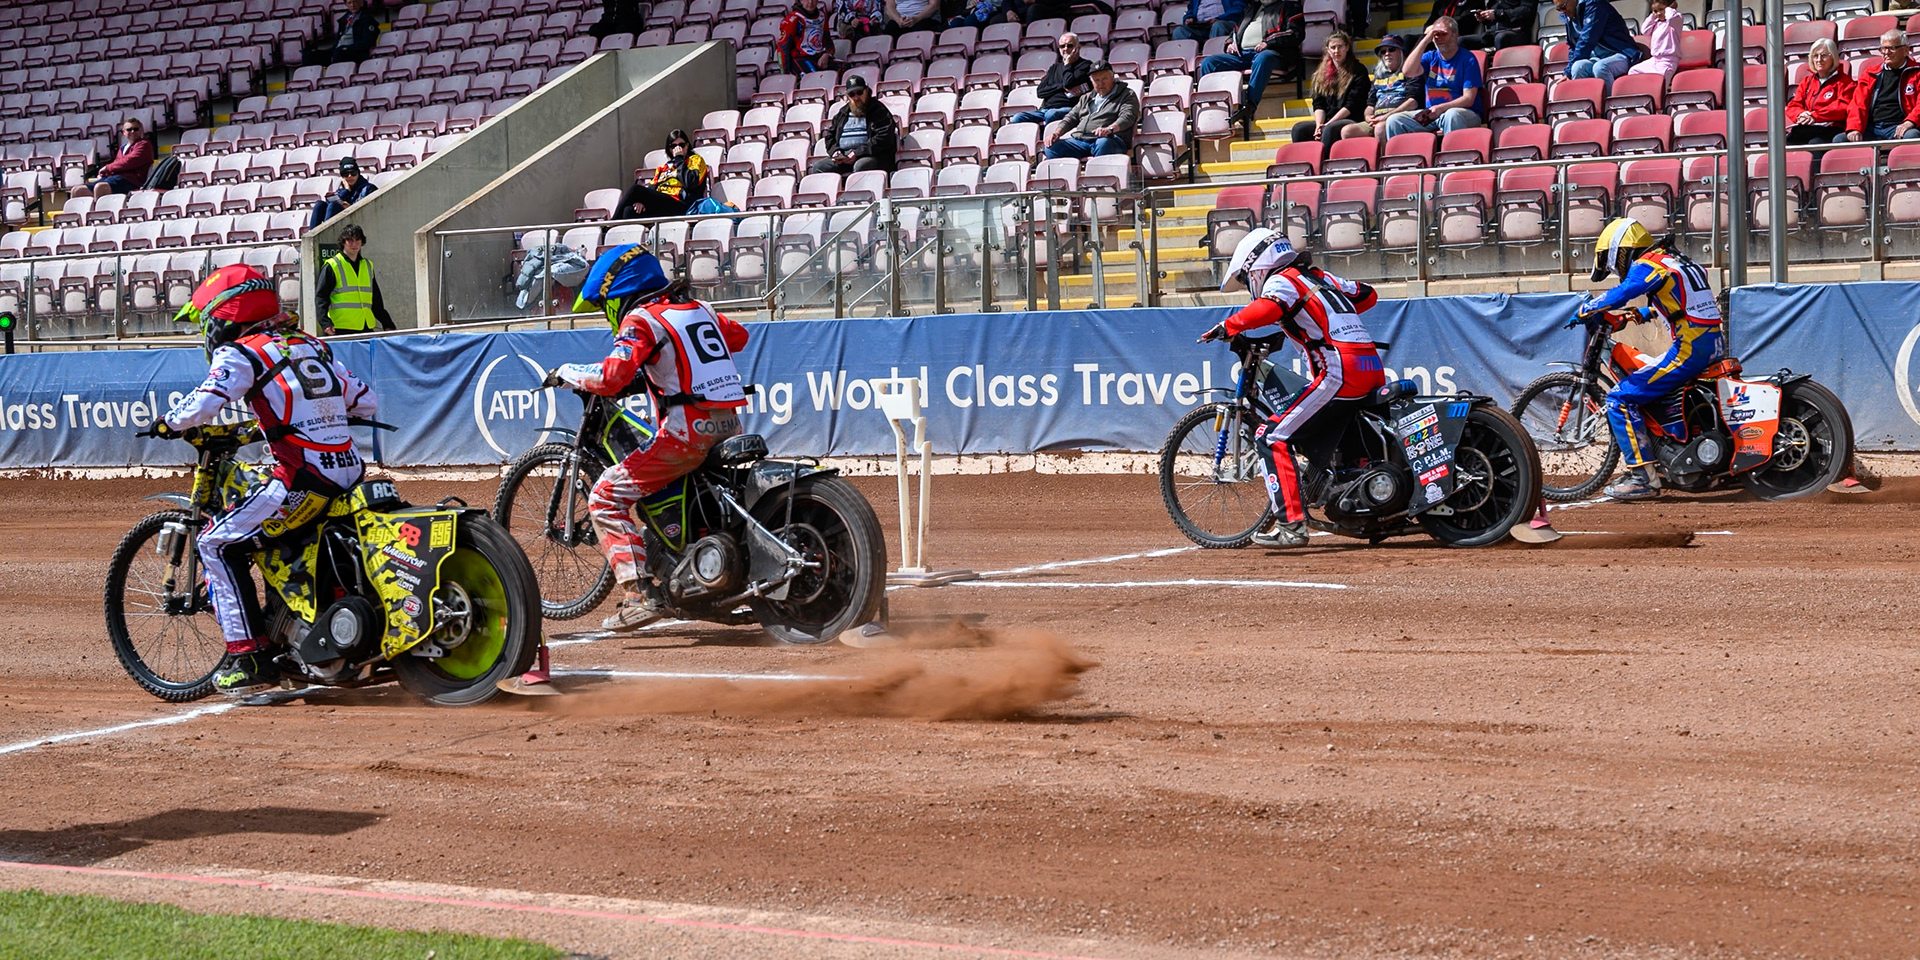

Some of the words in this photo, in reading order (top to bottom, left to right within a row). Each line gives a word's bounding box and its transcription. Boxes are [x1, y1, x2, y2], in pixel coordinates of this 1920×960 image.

[697, 324, 726, 357] 6
[299, 359, 334, 395] 9
[692, 382, 706, 392] THE
[706, 376, 725, 387] SLIDE
[945, 365, 1059, 408] Class
[1073, 360, 1212, 406] Travel
[62, 390, 158, 429] Travel
[488, 389, 540, 420] ATPI
[430, 521, 452, 547] 696
